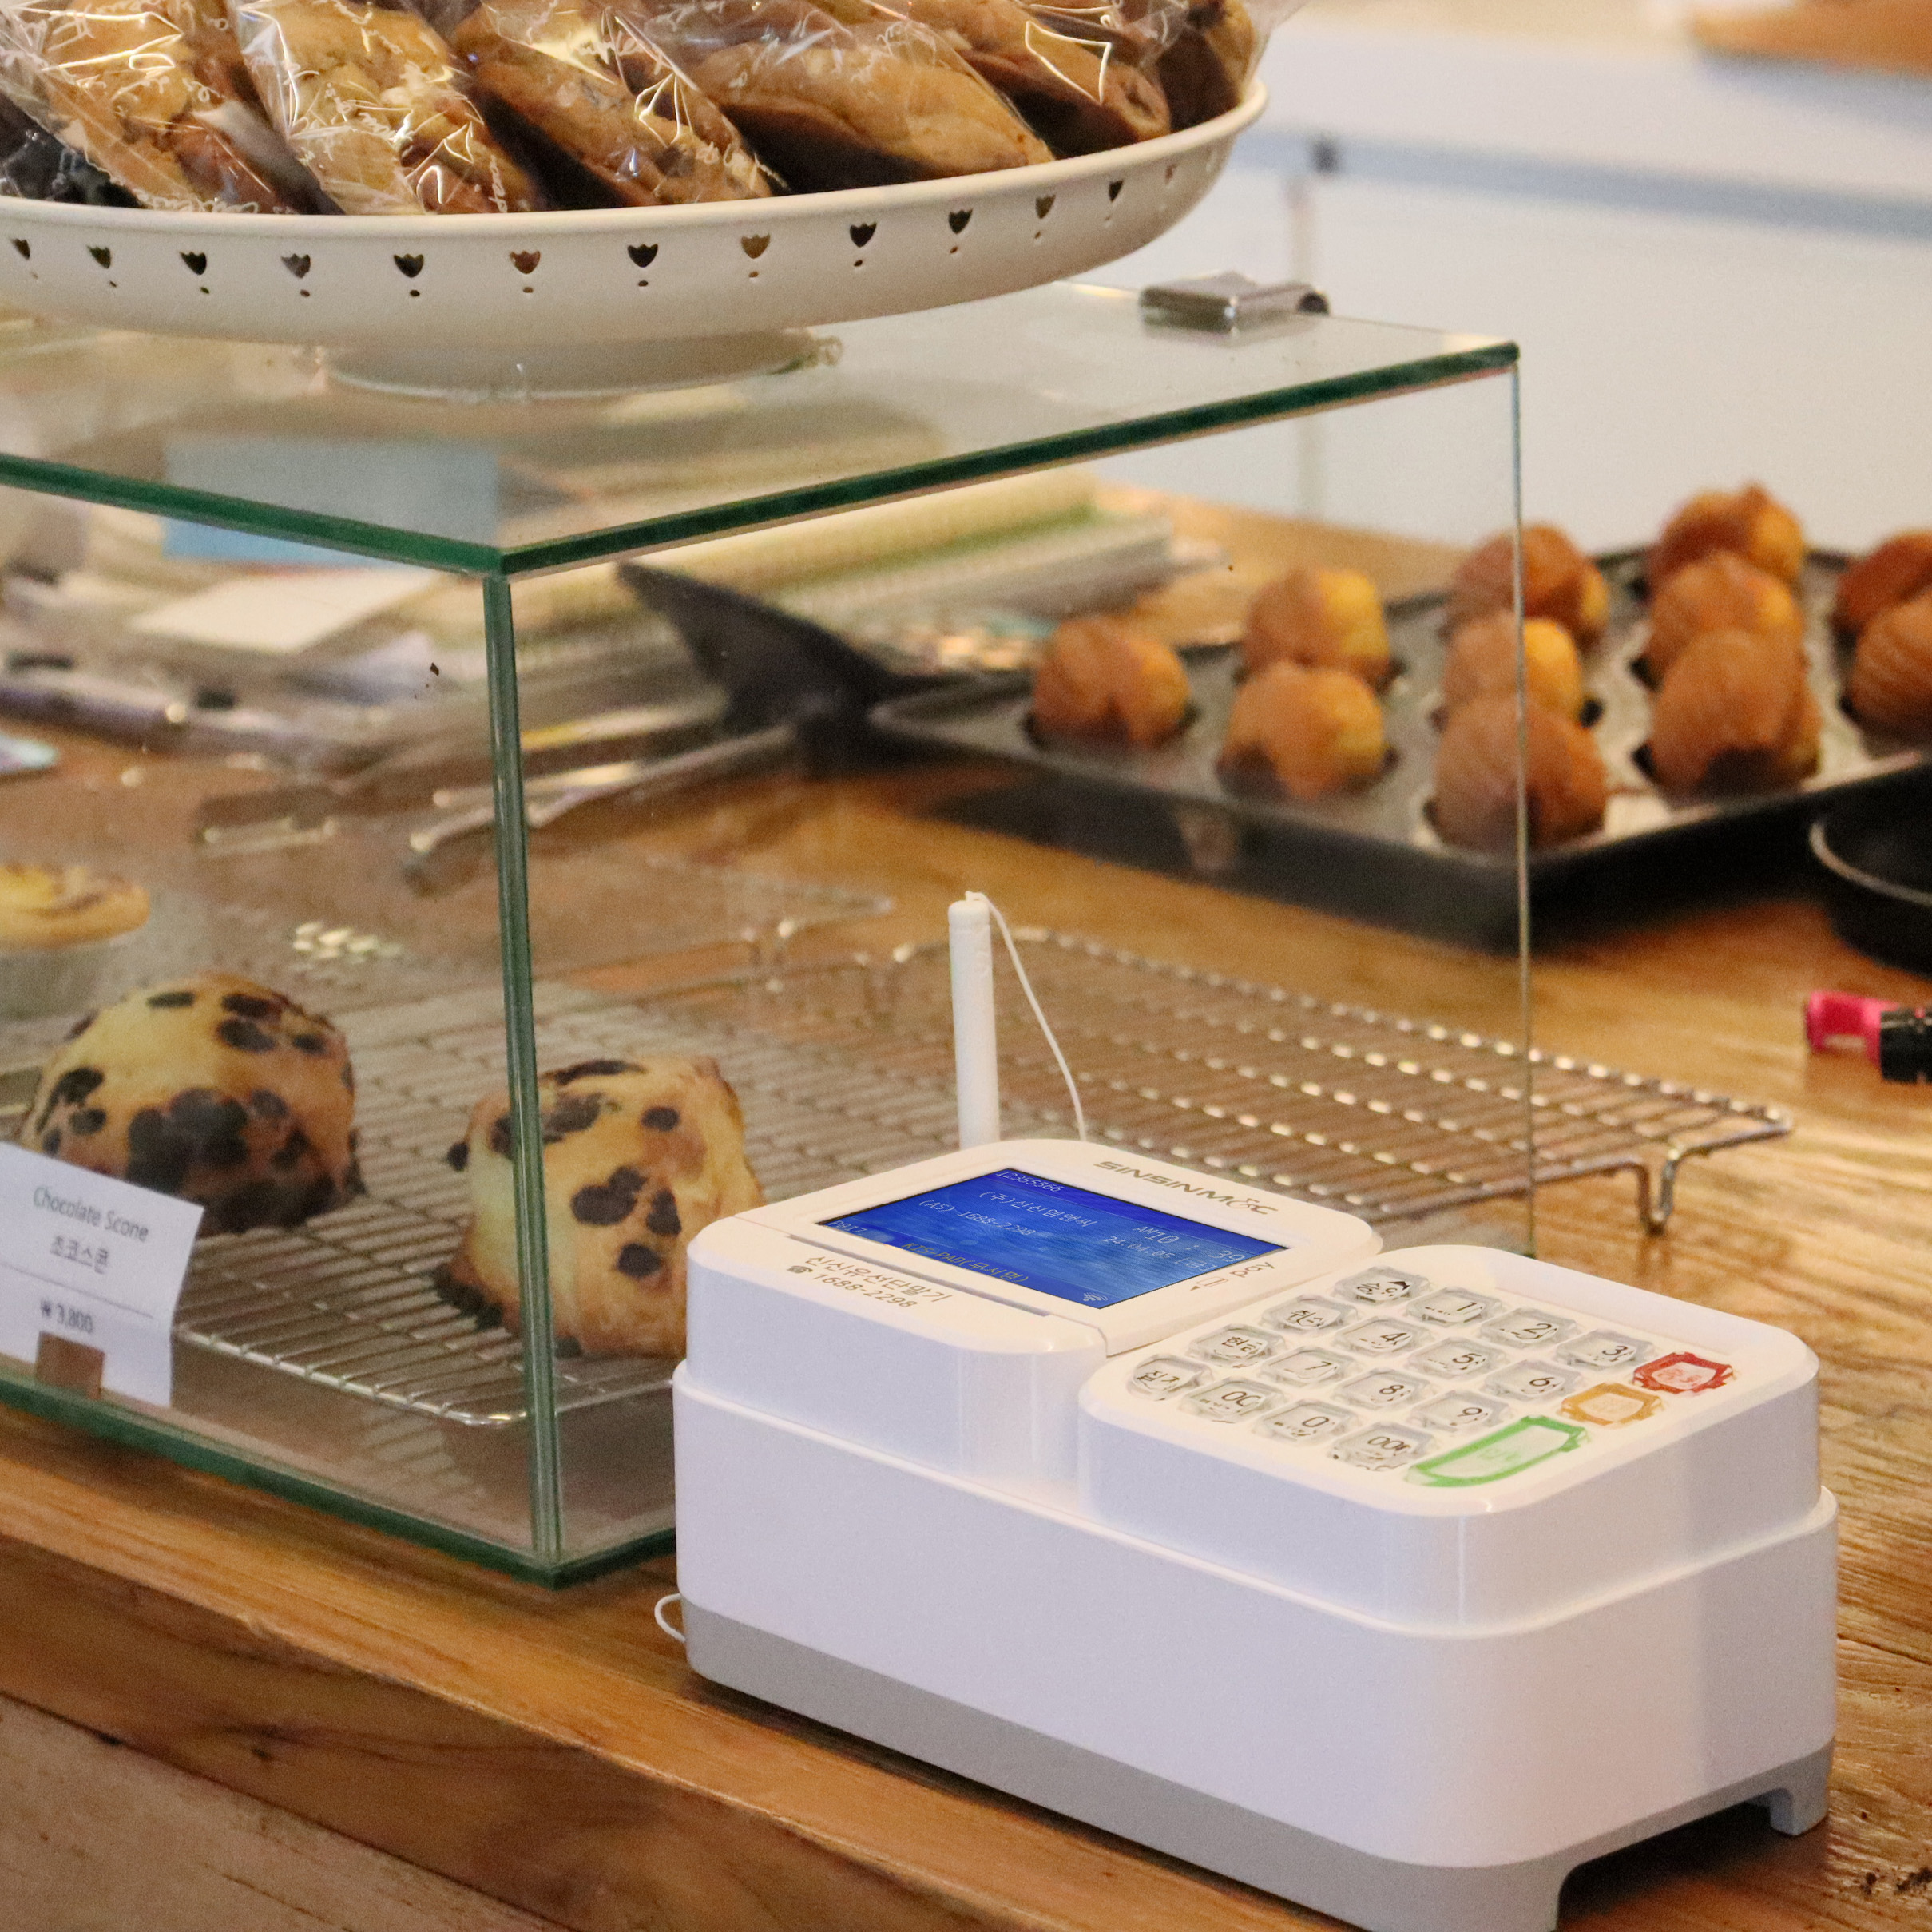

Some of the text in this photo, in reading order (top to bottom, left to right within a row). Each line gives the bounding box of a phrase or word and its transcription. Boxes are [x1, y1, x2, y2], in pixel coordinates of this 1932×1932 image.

[33, 1186, 149, 1243] Chocolate Scone
[918, 1199, 1037, 1236] (AS) 1688-2298
[1229, 1261, 1275, 1279] pay
[804, 1256, 953, 1303] 신신유선단말기
[812, 1272, 918, 1308] 1688-2298
[1524, 1323, 1553, 1335] 2
[1379, 1332, 1407, 1342] 4
[1601, 1345, 1628, 1356] 3
[1452, 1353, 1482, 1364] 5
[1529, 1376, 1556, 1387] 6
[1379, 1384, 1405, 1395] 8
[1456, 1406, 1483, 1418] 9
